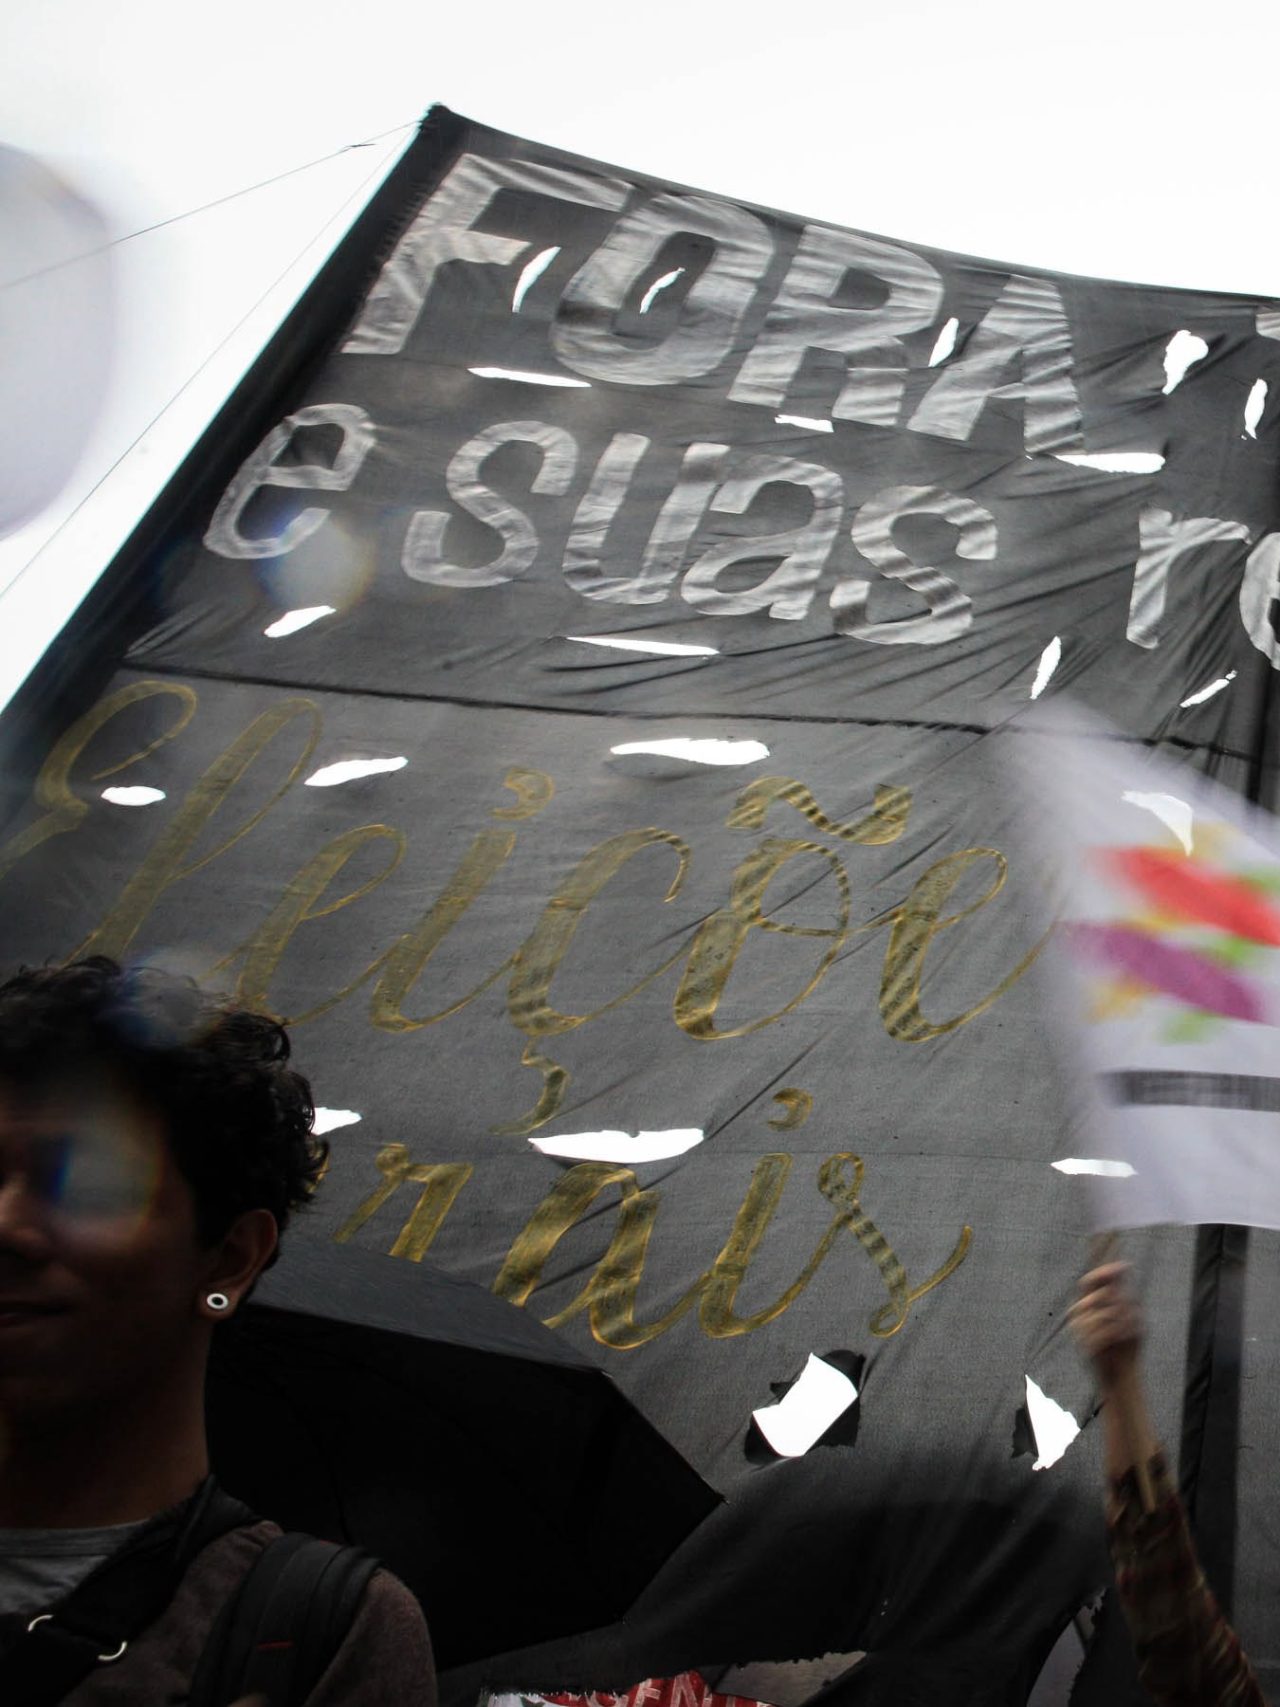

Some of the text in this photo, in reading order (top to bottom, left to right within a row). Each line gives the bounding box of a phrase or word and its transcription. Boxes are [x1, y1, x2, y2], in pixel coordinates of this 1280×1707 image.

[341, 152, 1084, 457] FORA
[203, 403, 377, 560] e
[402, 419, 999, 646] suas
